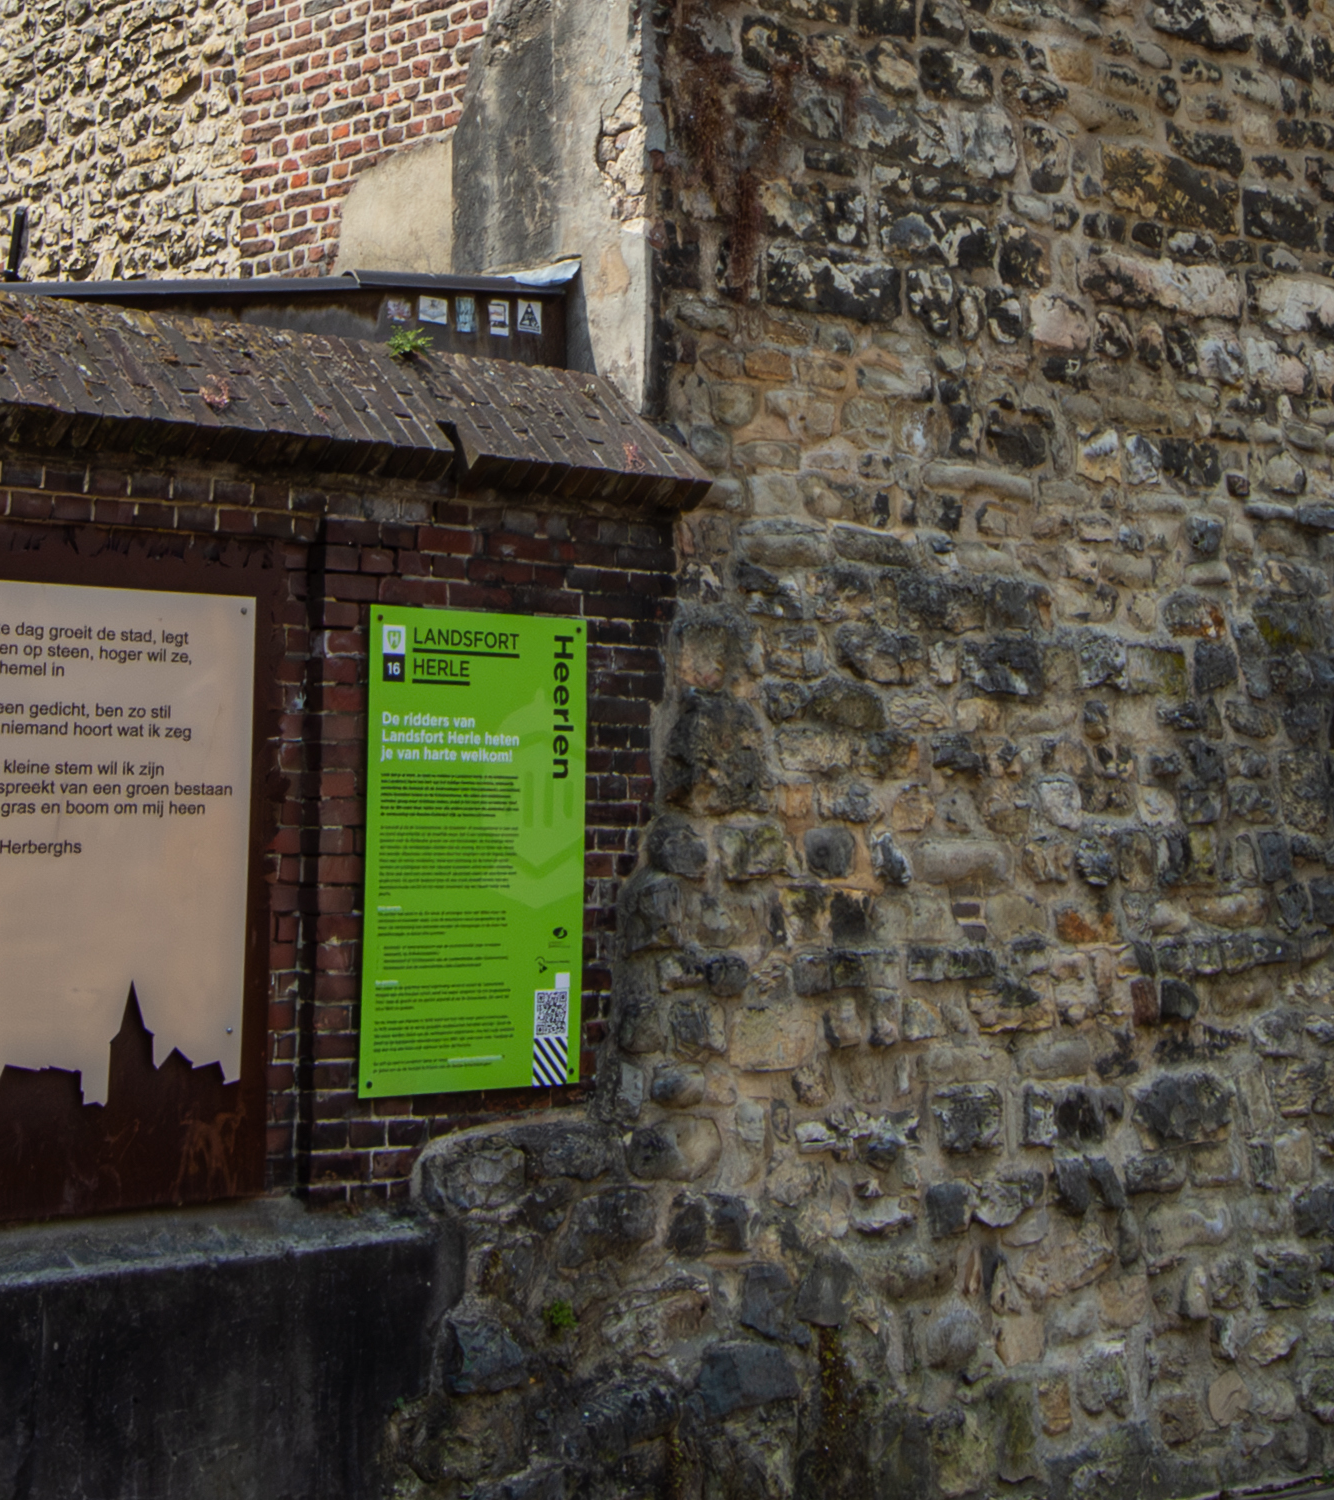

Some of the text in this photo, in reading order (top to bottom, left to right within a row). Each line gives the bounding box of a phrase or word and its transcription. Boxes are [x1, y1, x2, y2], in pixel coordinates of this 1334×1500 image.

[15, 622, 44, 640] dag
[49, 626, 92, 641] groeit
[97, 627, 115, 640] de
[121, 629, 156, 644] stad,
[162, 630, 188, 647] legt
[413, 627, 519, 650] LANDSFORT
[23, 645, 42, 659] op
[48, 645, 93, 660] steen,
[100, 646, 142, 663] hoger
[147, 649, 166, 662] wil
[171, 652, 191, 665] ze,
[0, 660, 46, 676] hemel
[52, 662, 64, 676] in
[387, 662, 400, 676] 16
[413, 658, 470, 677] HERLE
[30, 702, 89, 718] gedicht,
[96, 703, 123, 717] ben
[128, 707, 146, 718] zo
[151, 705, 171, 718] stil
[553, 635, 574, 779] Heerlen
[382, 711, 475, 728] De ridders van
[1, 720, 68, 735] niemand
[74, 722, 112, 736] hoort
[117, 725, 143, 737] wat
[149, 724, 160, 737] ik
[165, 728, 191, 741] zeg
[381, 729, 519, 746] Landsfort Herle heten
[380, 746, 513, 762] je van harte welkom!
[4, 760, 50, 774] kleine
[55, 762, 92, 774] stem
[98, 761, 117, 775] wil
[123, 762, 134, 775] ik
[139, 762, 164, 779] zijn
[60, 783, 87, 794] van
[93, 784, 121, 795] een
[126, 784, 169, 798] groen
[175, 782, 232, 795] bestaan
[1, 803, 35, 817] gras
[41, 803, 60, 814] en
[66, 800, 108, 814] boom
[114, 804, 137, 814] om
[143, 801, 163, 818] mij
[169, 801, 205, 814] heen
[0, 840, 81, 857] Herberghs
